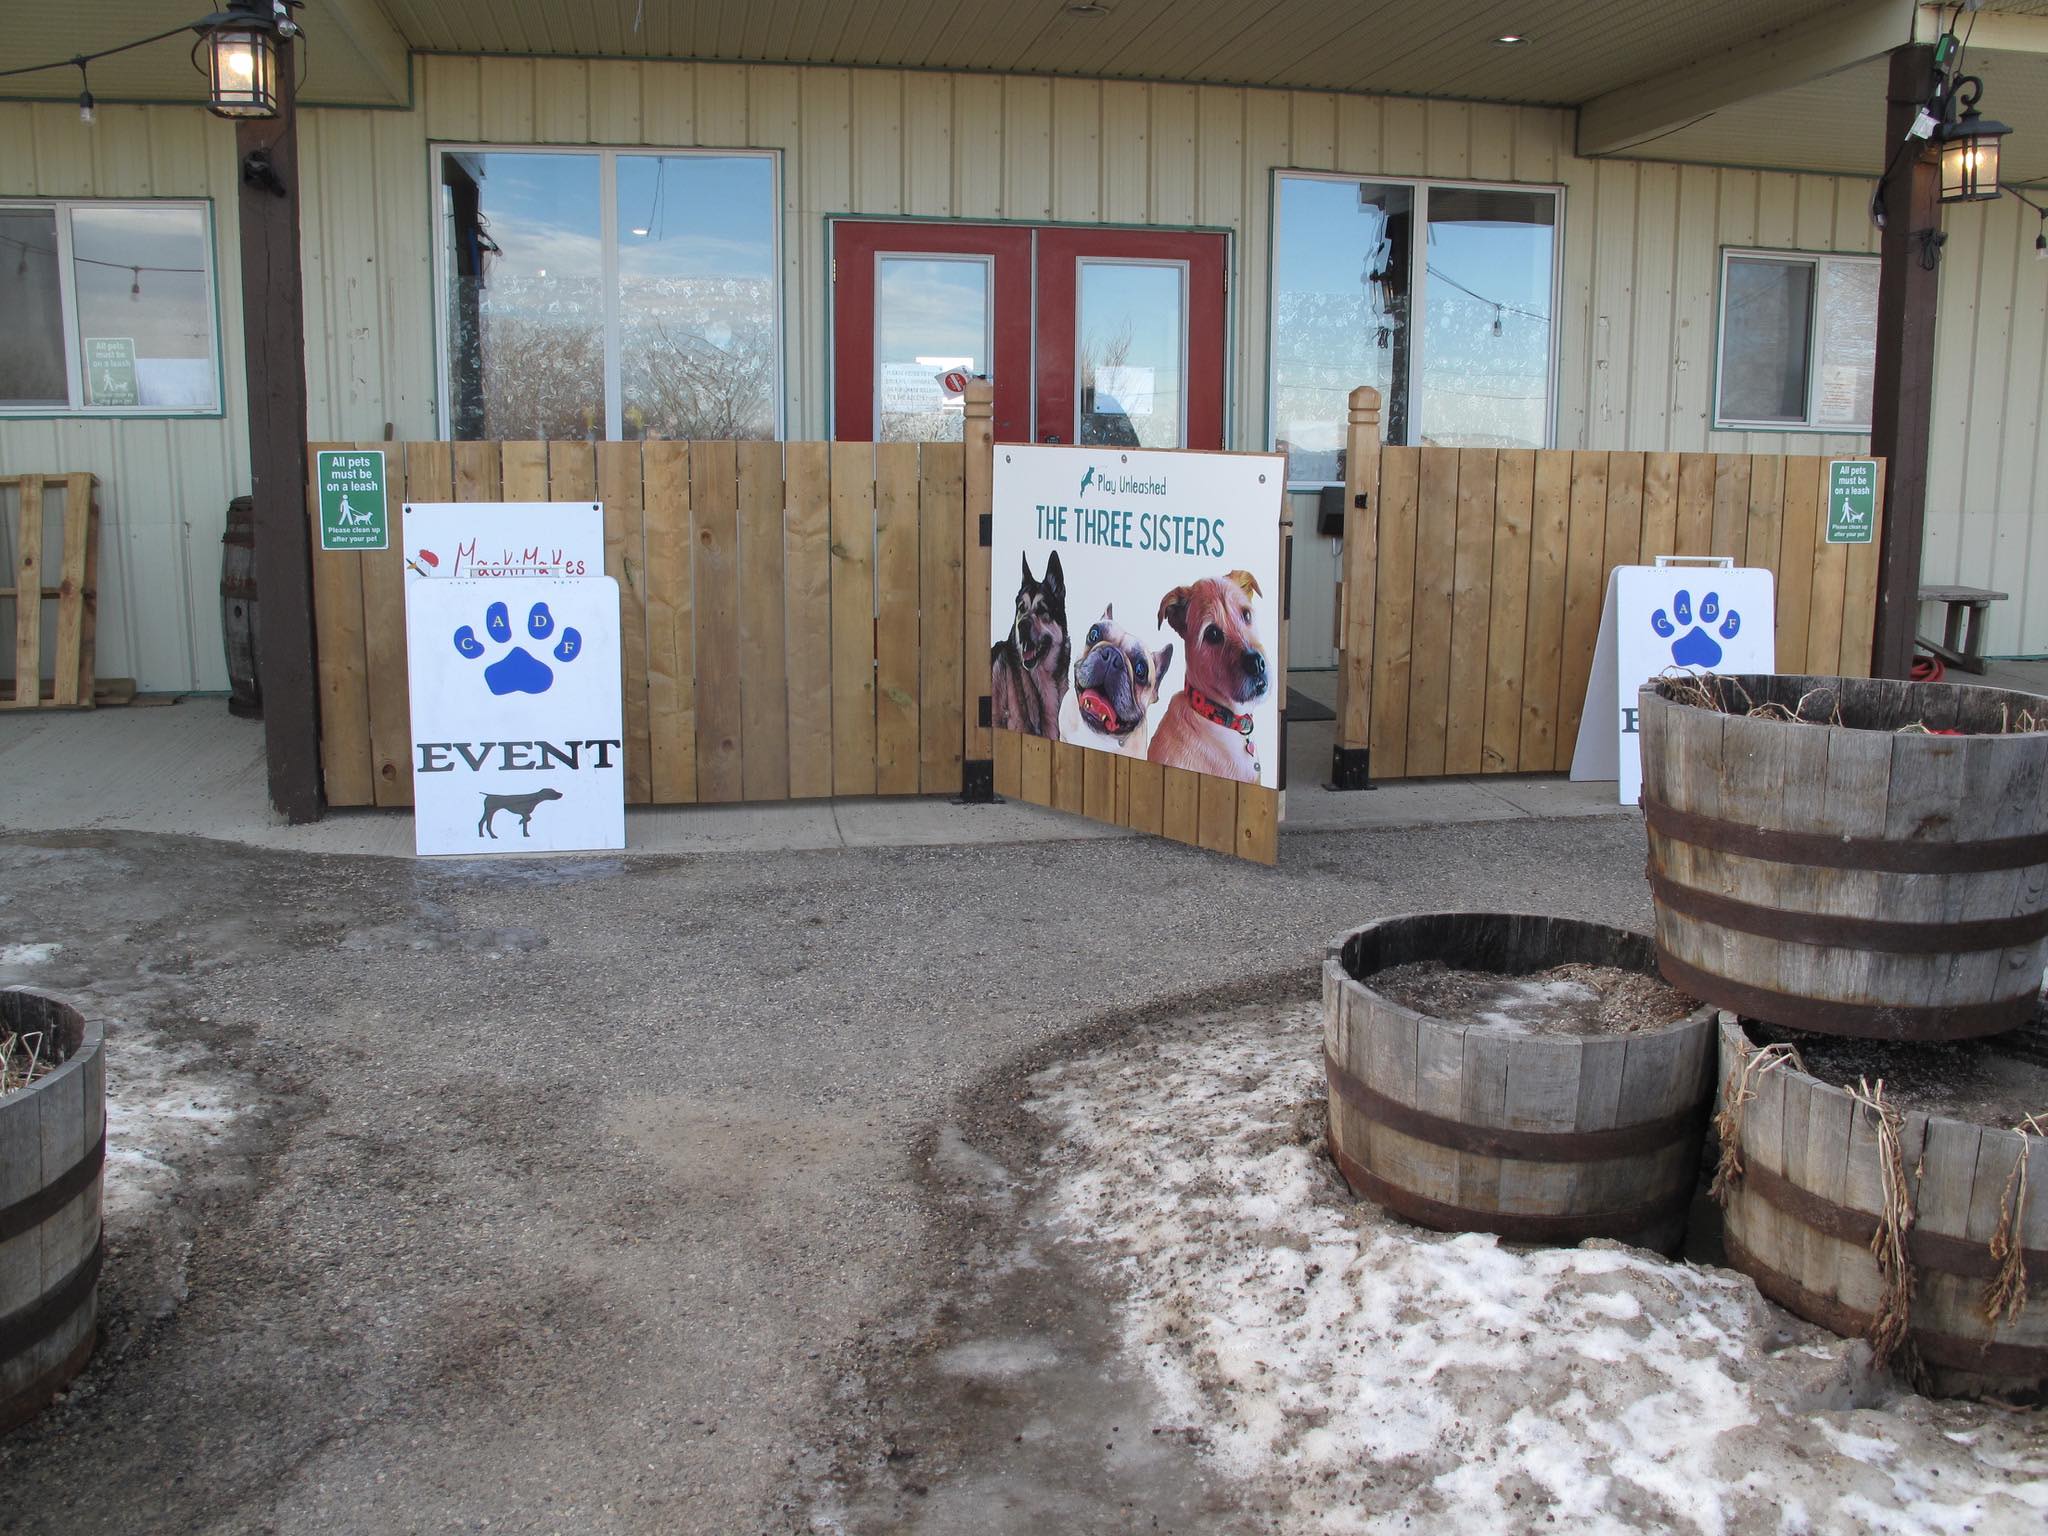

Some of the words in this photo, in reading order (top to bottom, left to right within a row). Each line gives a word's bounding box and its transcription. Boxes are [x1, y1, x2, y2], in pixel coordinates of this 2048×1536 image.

[332, 456, 345, 467] All
[348, 457, 370, 469] pets
[332, 470, 357, 479] must
[360, 469, 372, 479] be
[1839, 466, 1850, 475] All
[1851, 466, 1867, 476] pets
[1097, 474, 1116, 495] Play
[1119, 475, 1167, 496] Unleashed
[1838, 477, 1857, 485] must
[1858, 476, 1867, 485] be
[327, 483, 339, 491] on
[342, 483, 348, 491] a
[351, 481, 378, 491] leash
[1851, 486, 1870, 495] leash
[372, 527, 381, 535] up
[1036, 504, 1068, 542] THE
[1074, 508, 1133, 548] THREE
[1139, 512, 1225, 558] SISTERS
[366, 535, 377, 543] pet
[416, 739, 621, 772] EVENT
